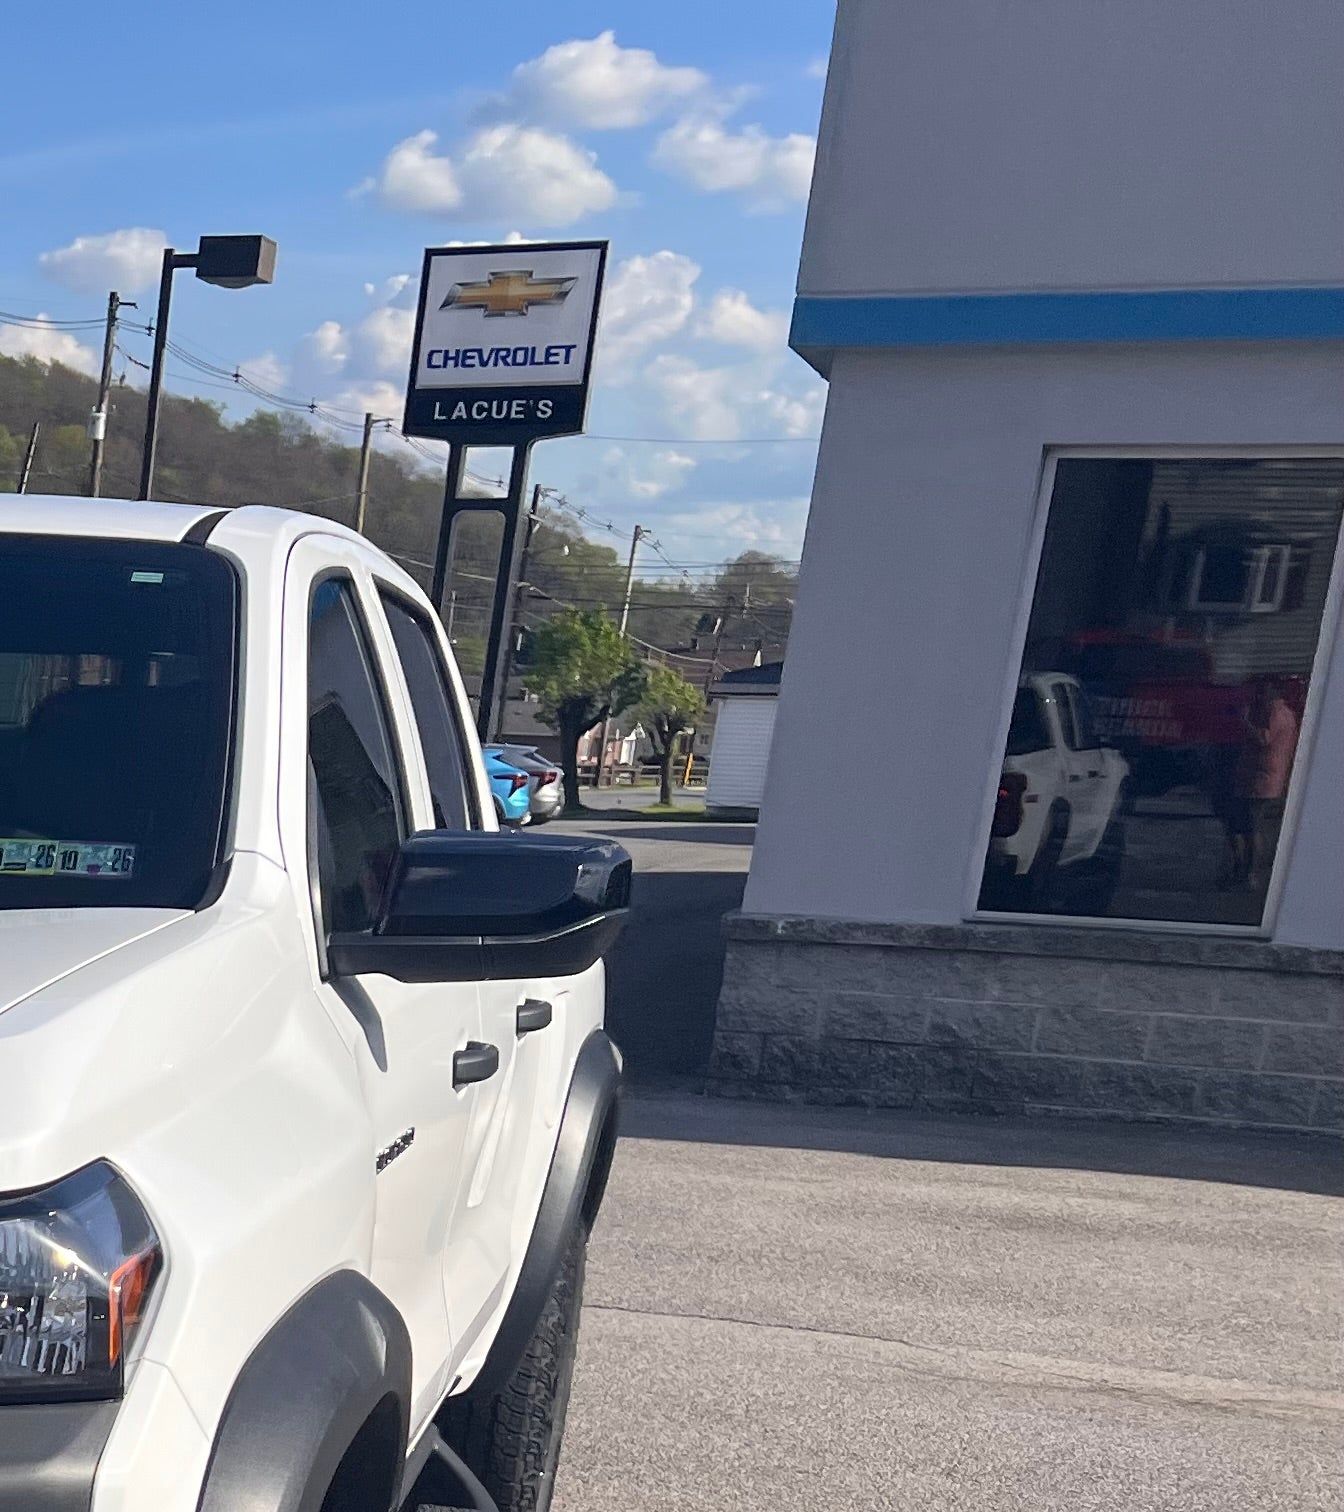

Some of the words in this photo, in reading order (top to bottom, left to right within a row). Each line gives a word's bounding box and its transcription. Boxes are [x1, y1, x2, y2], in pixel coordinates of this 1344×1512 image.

[426, 344, 577, 369] CHEVROLET
[433, 399, 554, 421] LACUE'S
[35, 844, 56, 868] 26
[60, 850, 79, 871] 10
[112, 847, 134, 872] 26
